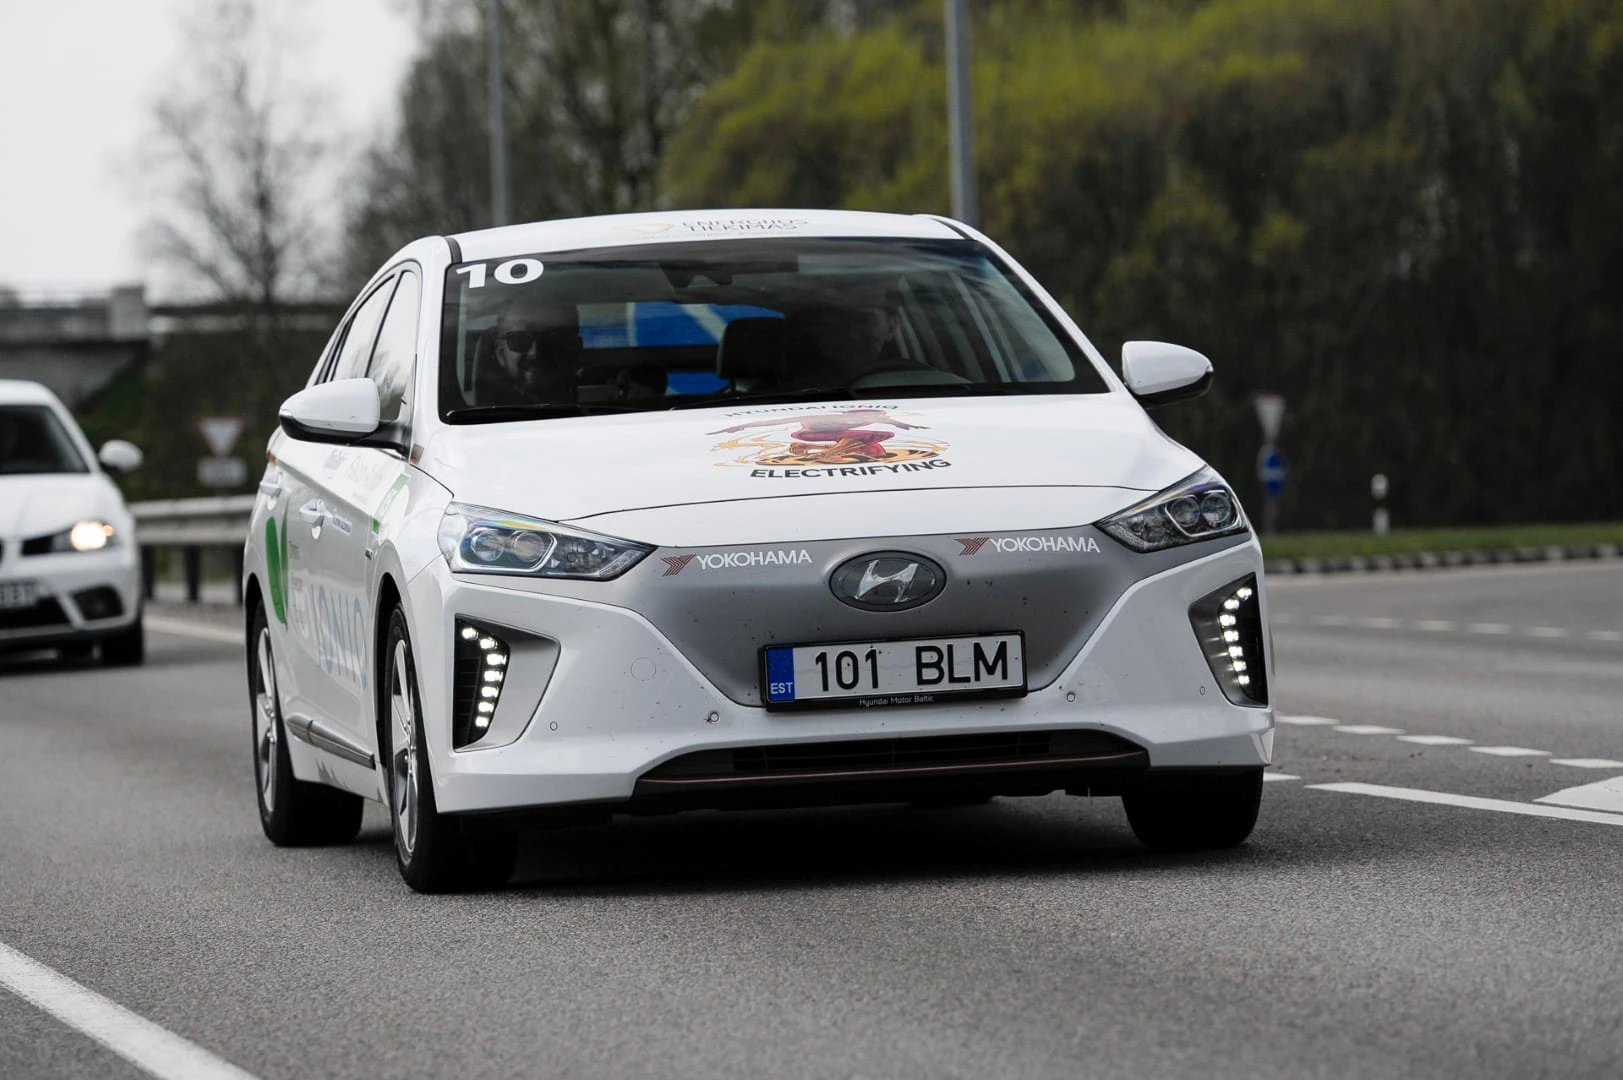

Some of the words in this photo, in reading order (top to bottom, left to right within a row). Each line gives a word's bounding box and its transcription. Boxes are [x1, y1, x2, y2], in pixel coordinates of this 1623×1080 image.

[455, 258, 544, 289] 10
[750, 459, 952, 478] ELECTRIFYING
[988, 536, 1101, 554] YOKOHAMA
[696, 549, 813, 570] YOKOHAMA
[815, 648, 880, 692] 101
[915, 640, 1009, 686] BLM
[770, 682, 794, 695] EST
[859, 697, 889, 707] Hyundai
[890, 696, 913, 705] Motor
[914, 695, 935, 703] Baltic
